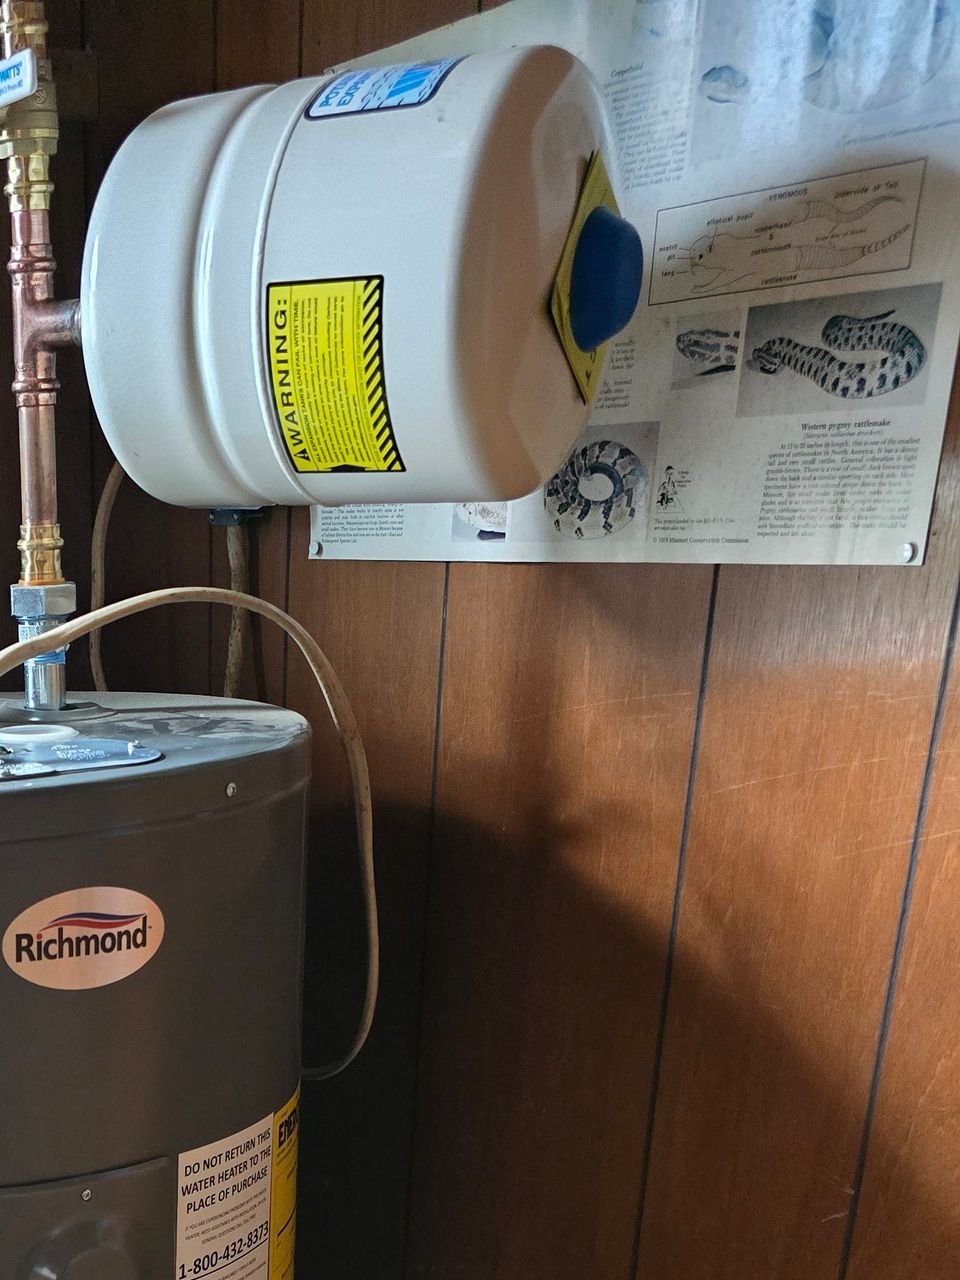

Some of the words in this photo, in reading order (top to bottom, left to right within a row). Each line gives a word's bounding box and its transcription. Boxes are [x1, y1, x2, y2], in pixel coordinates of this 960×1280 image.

[769, 188, 808, 201] VENOMOUS
[274, 298, 304, 448] WARNING:
[298, 388, 308, 413] TANKS
[801, 422, 827, 431] Western
[828, 421, 851, 431] pygmy
[853, 418, 891, 428] rattlesnake
[15, 915, 148, 963] Richmond
[181, 1175, 215, 1197] WATER
[217, 1161, 248, 1184] HEATER
[249, 1154, 259, 1168] TO
[260, 1145, 272, 1161] THE
[184, 1162, 200, 1177] DO
[203, 1153, 223, 1171] NOT
[225, 1138, 256, 1163] RETURN
[257, 1128, 271, 1144] THIS
[186, 1193, 216, 1214] PLACE
[218, 1187, 230, 1202] OF
[232, 1165, 268, 1196] PURCHASE
[178, 1220, 269, 1280] 1-800-432-8373
